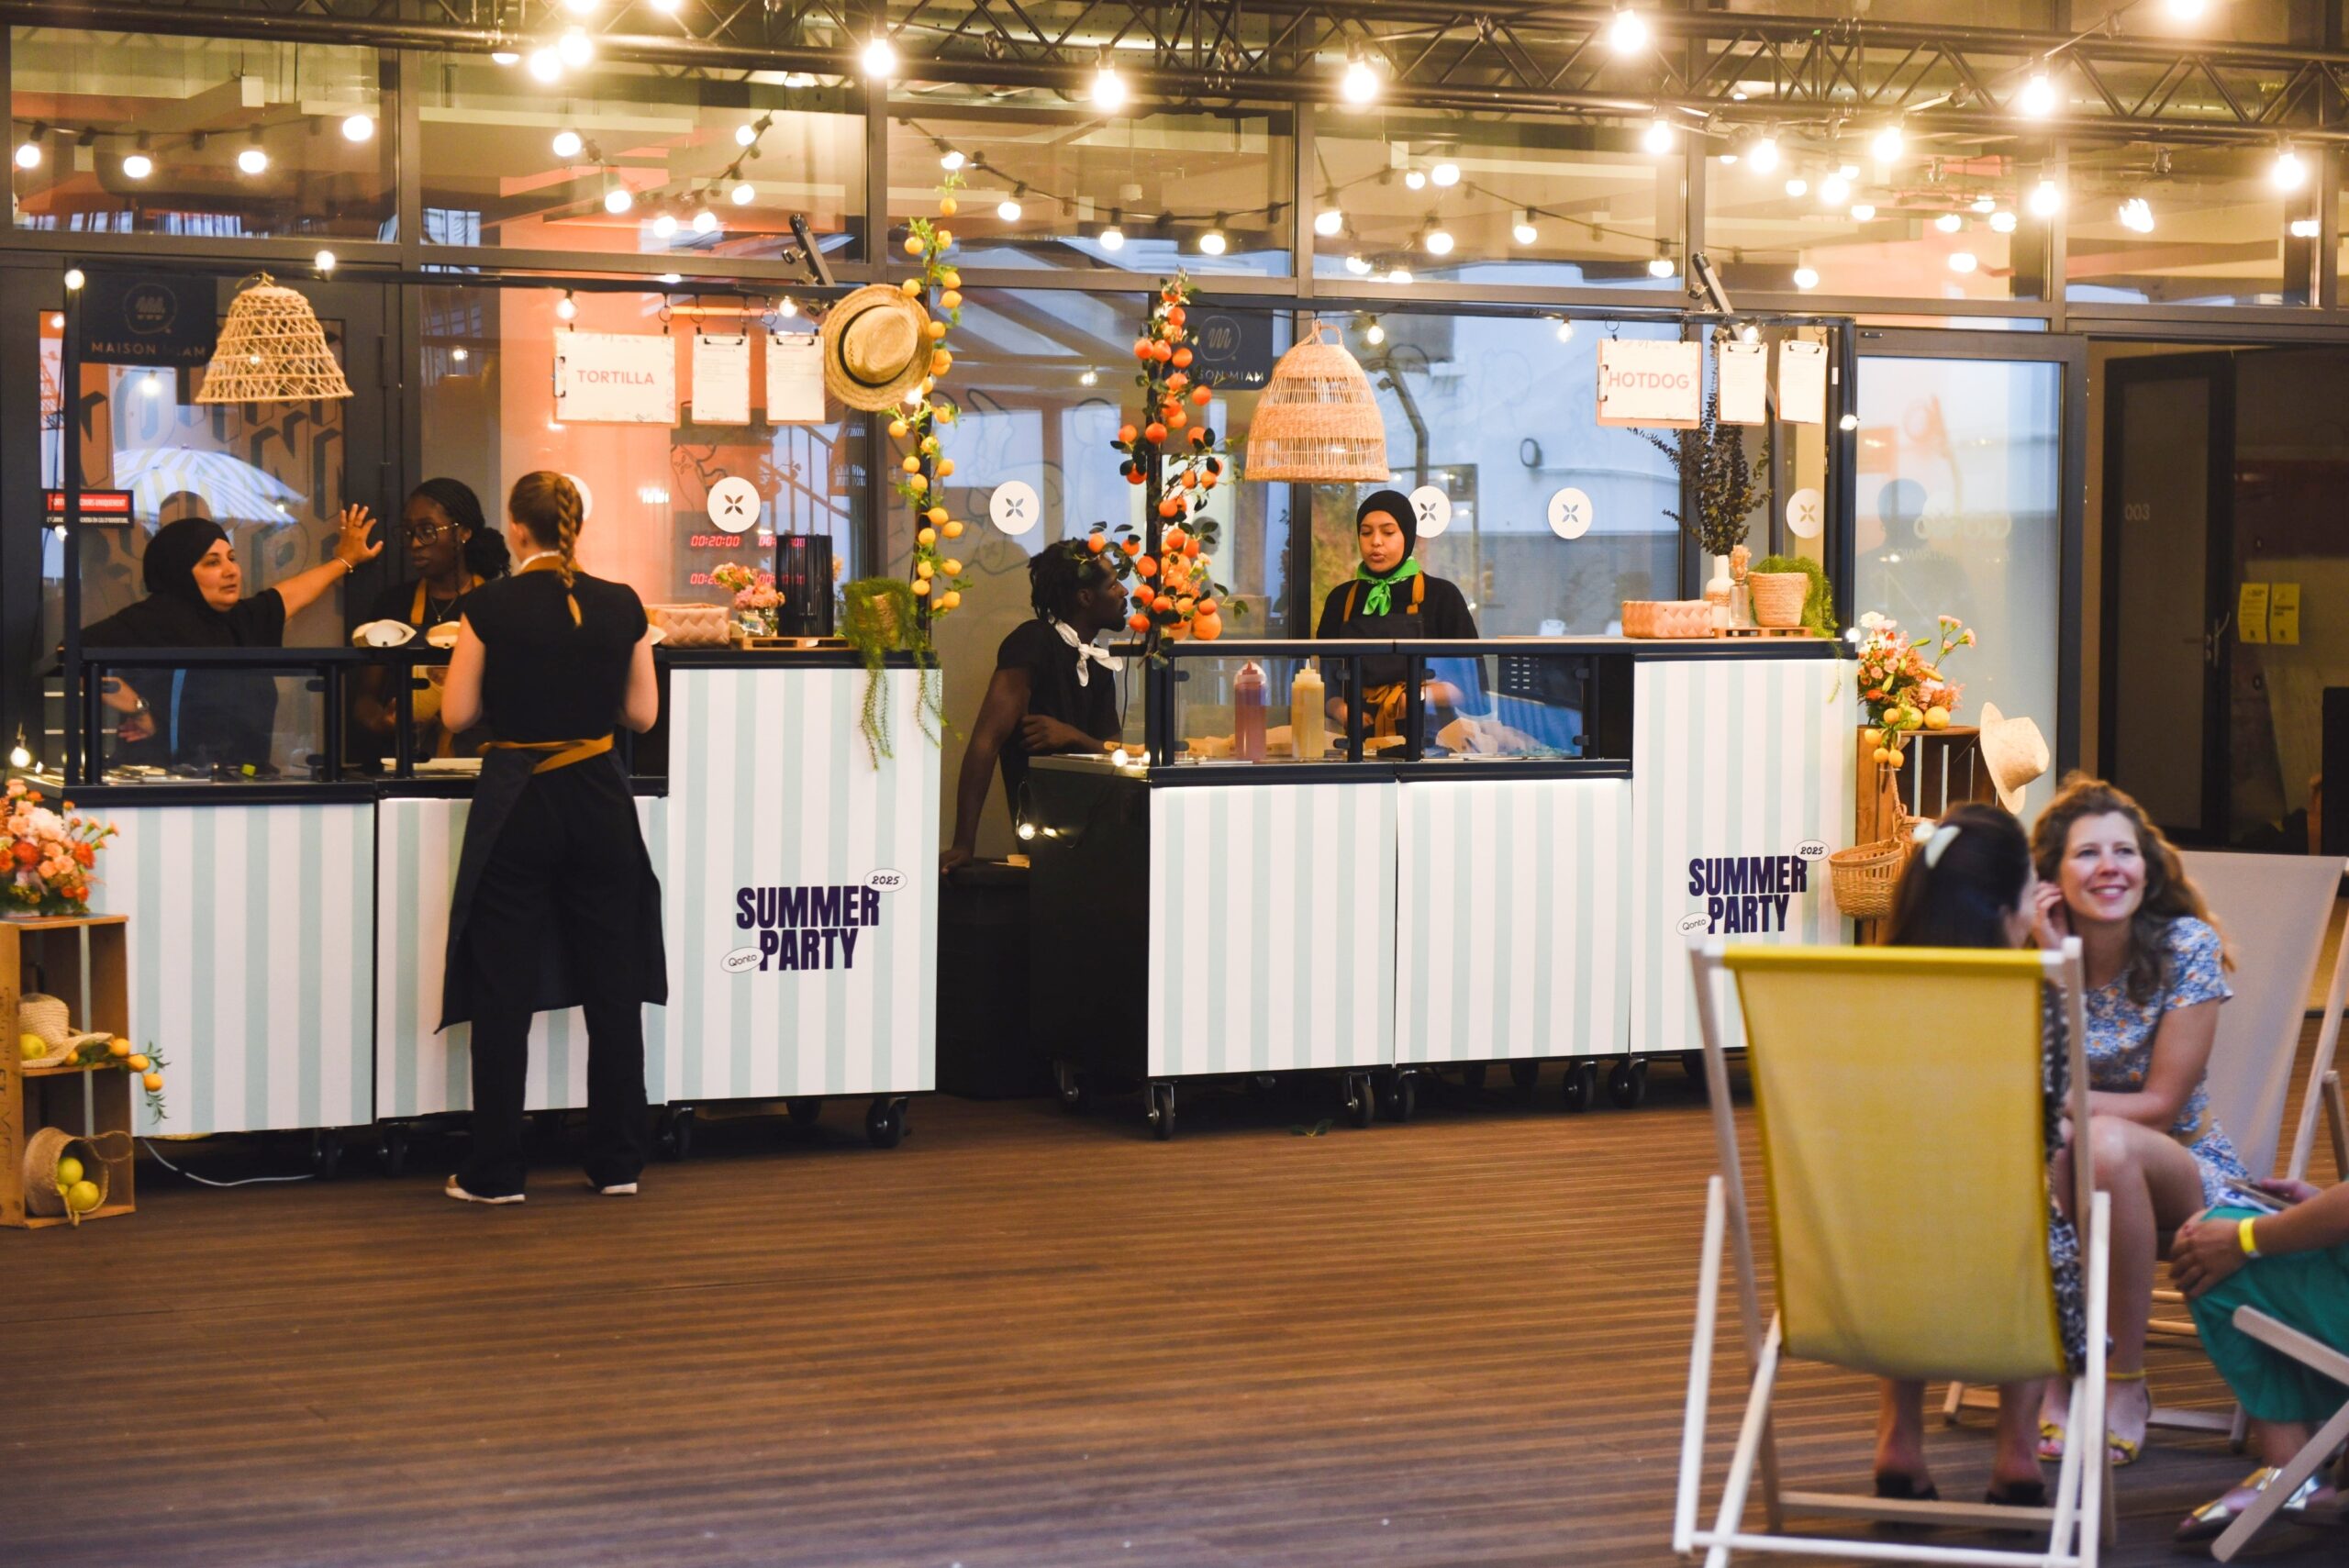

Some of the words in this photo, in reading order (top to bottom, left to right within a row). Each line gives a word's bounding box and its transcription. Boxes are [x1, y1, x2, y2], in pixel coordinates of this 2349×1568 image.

[91, 341, 157, 355] MAISON
[576, 370, 655, 385] TORTILLA
[1230, 371, 1264, 383] MIAM
[1609, 372, 1690, 389] HOTDOG
[2125, 504, 2150, 520] 003
[690, 535, 741, 547] 00:20:00
[1799, 846, 1825, 855] 2025
[871, 875, 900, 885] 2025
[1688, 855, 1808, 896] SUMMER
[736, 885, 880, 929] SUMMER
[1708, 895, 1790, 935] PARTY
[1682, 918, 1707, 931] Qonto
[759, 928, 859, 972] PARTY
[728, 953, 758, 967] Qonto
